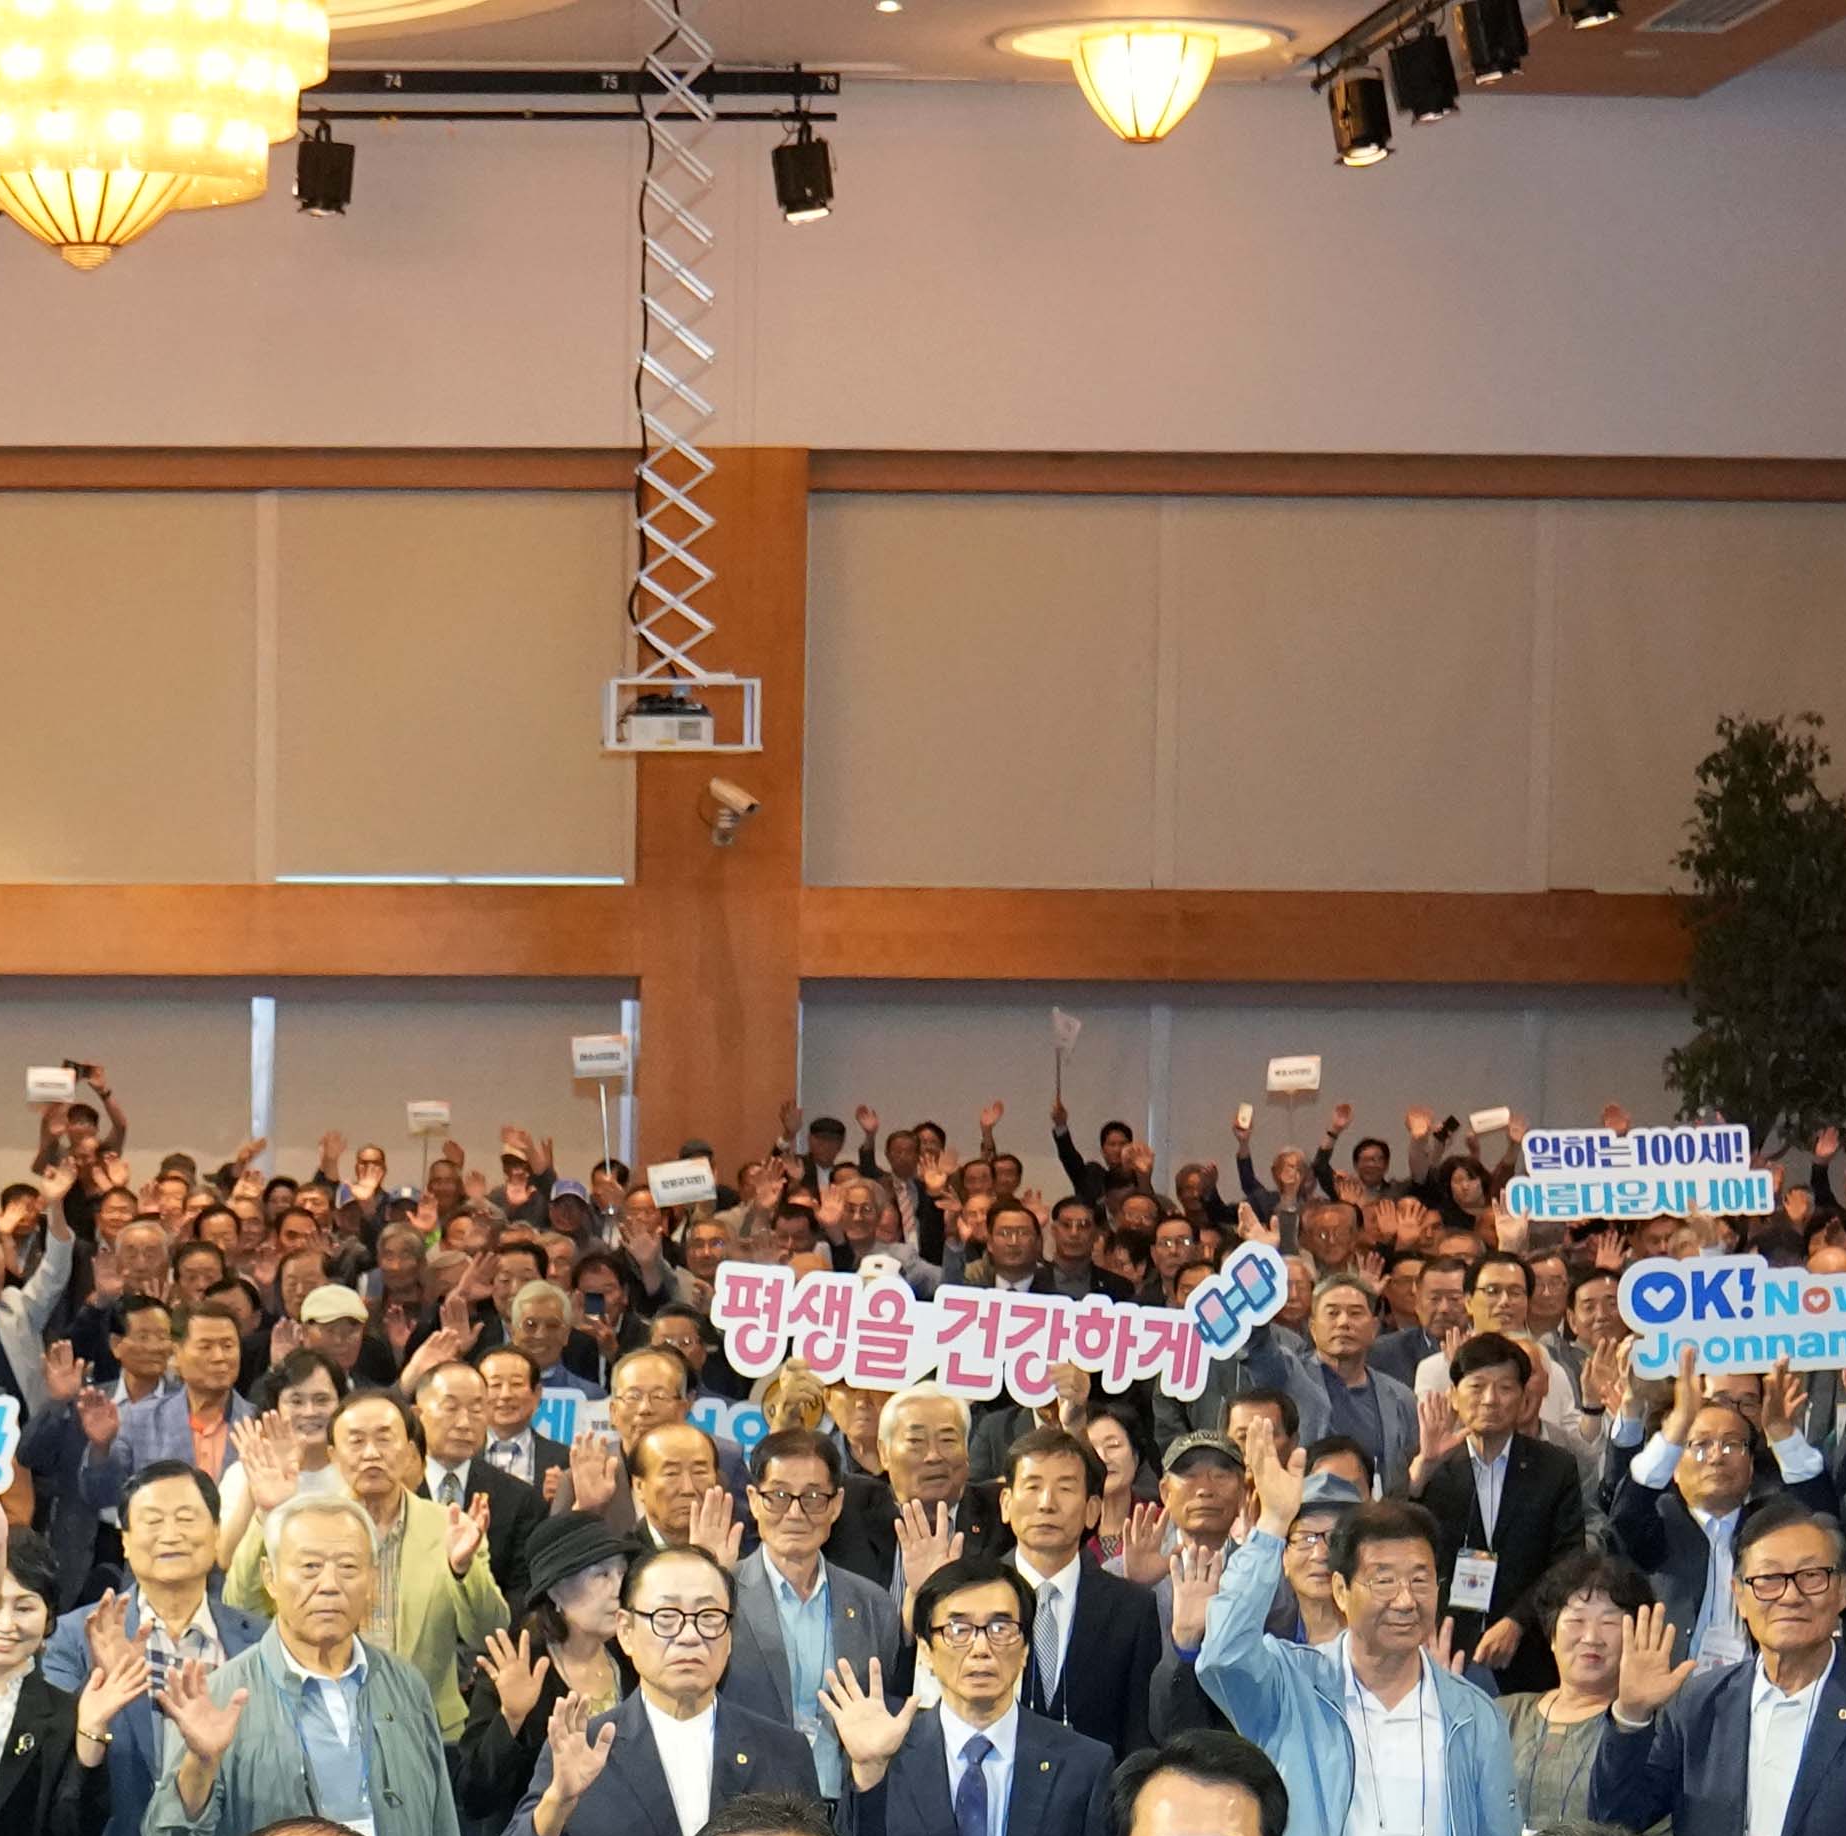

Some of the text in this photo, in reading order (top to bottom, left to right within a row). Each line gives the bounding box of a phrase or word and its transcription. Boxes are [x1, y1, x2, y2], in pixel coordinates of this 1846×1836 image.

[384, 73, 403, 88] 74
[600, 74, 619, 89] 75
[818, 75, 836, 91] 76
[1511, 1179, 1769, 1215] 아름다운시니어!
[1631, 1267, 1754, 1323] OK!
[721, 1273, 1203, 1392] 평생을 건강하게
